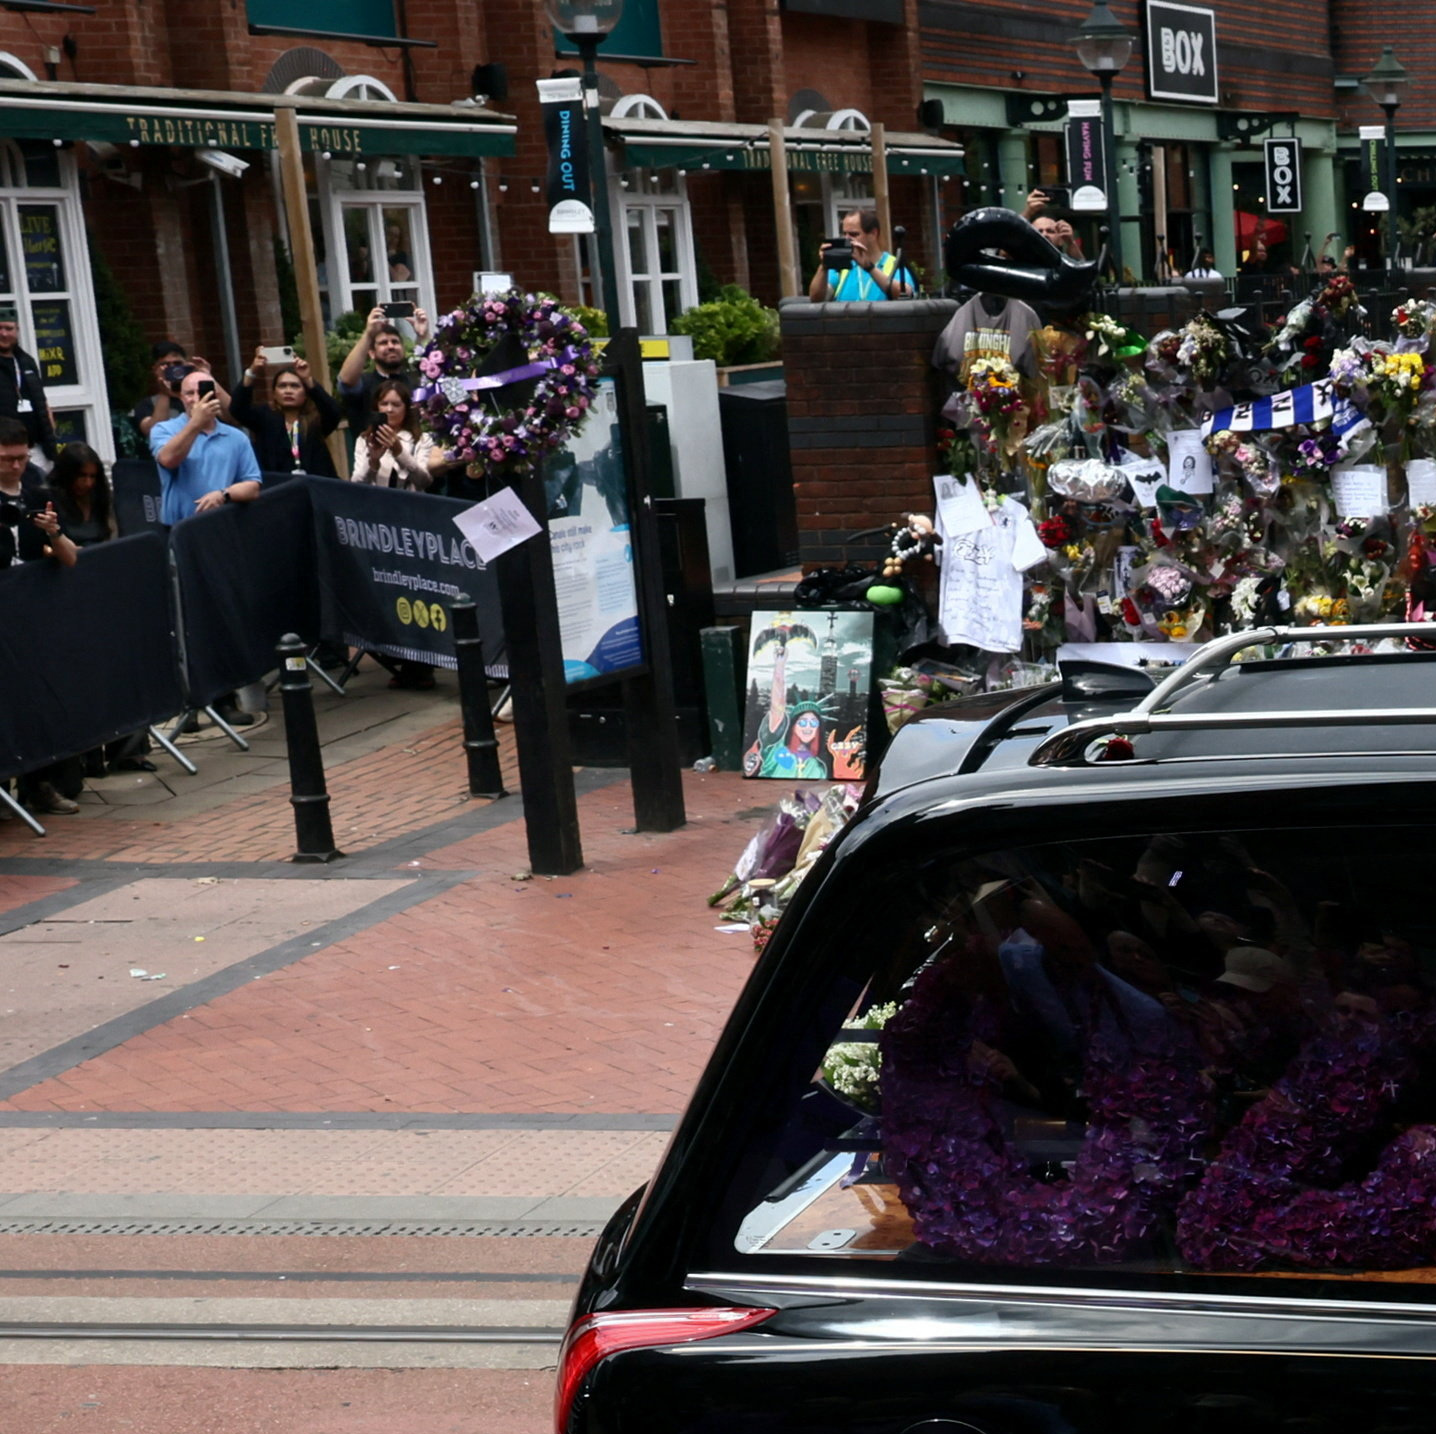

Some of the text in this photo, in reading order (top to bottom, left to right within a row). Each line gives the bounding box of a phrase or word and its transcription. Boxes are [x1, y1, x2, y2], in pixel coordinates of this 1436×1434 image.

[1160, 26, 1205, 77] BOX
[559, 110, 575, 192] DINING OUT
[1273, 146, 1293, 204] BOX
[373, 566, 461, 596] brindleyplace.com
